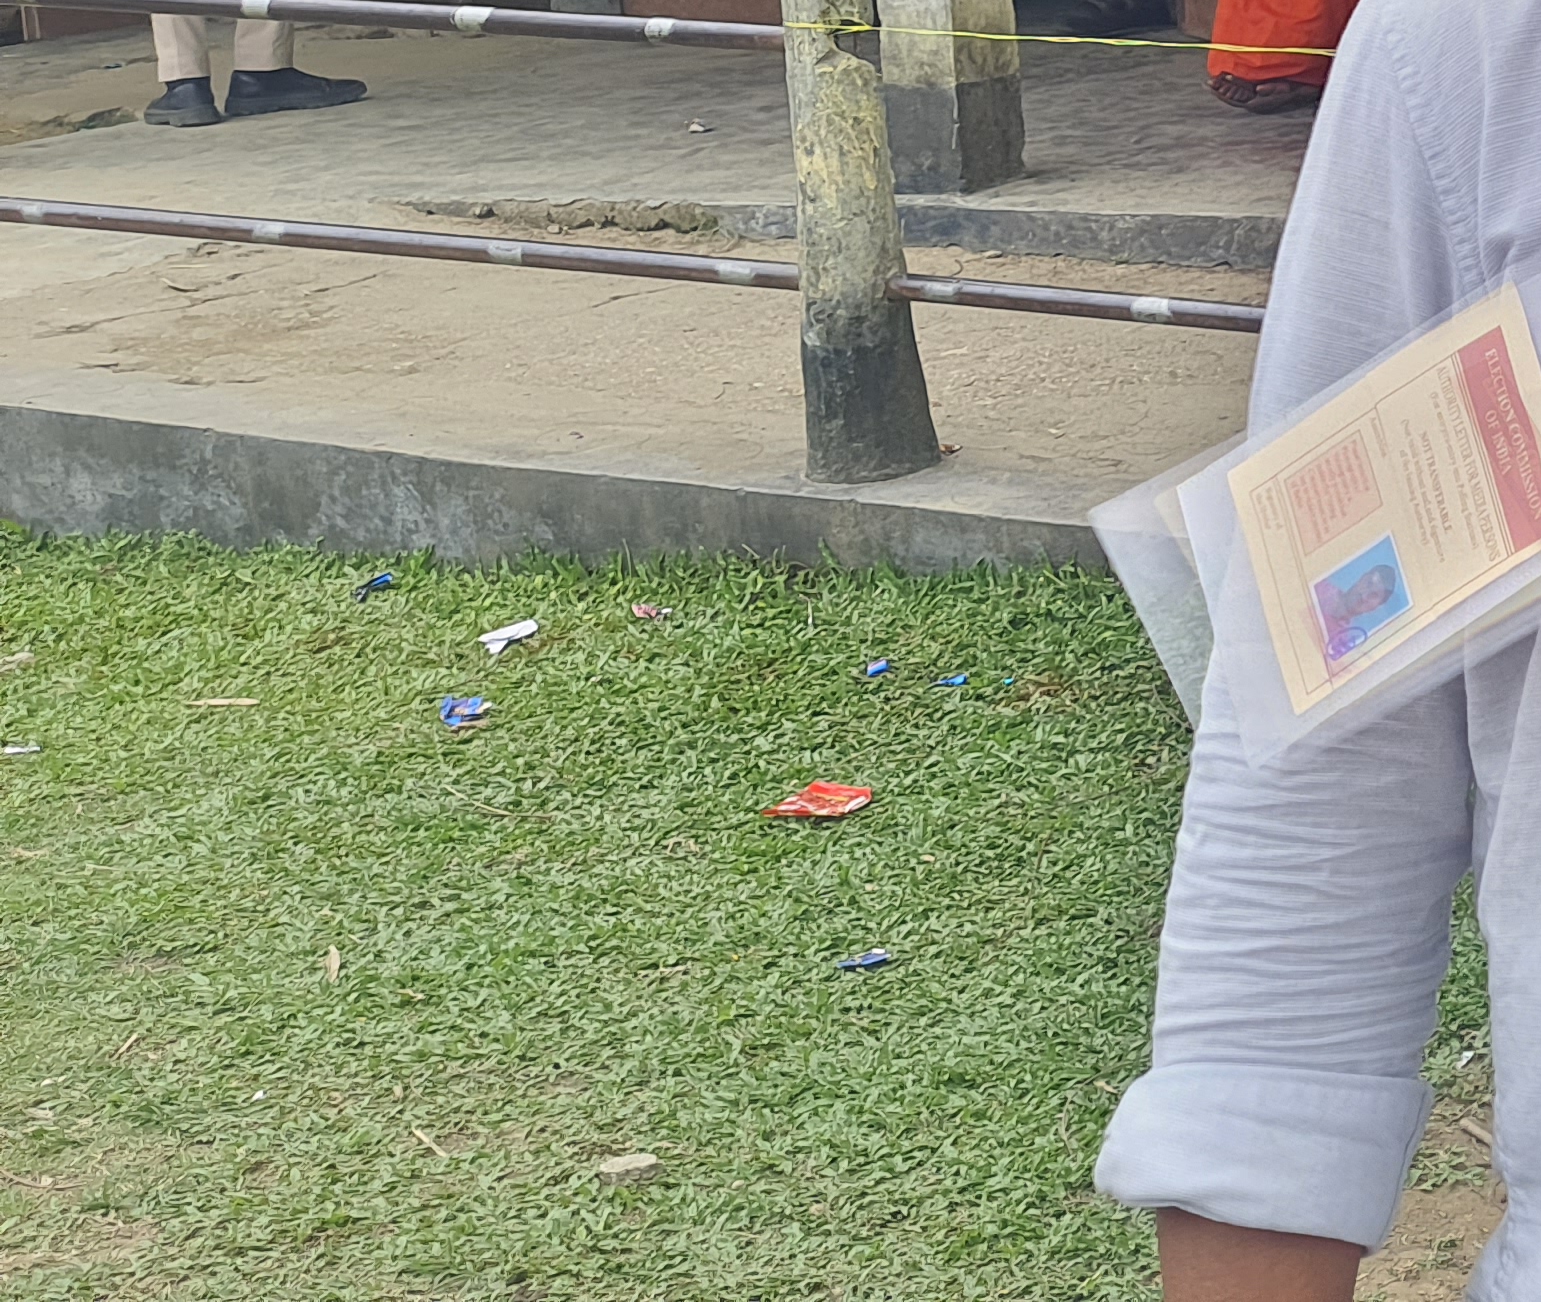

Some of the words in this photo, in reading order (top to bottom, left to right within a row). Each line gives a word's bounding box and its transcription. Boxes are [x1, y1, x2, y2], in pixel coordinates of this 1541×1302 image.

[1484, 347, 1515, 423] ELECTION
[1484, 409, 1499, 430] OF
[1491, 431, 1512, 476] INDIA
